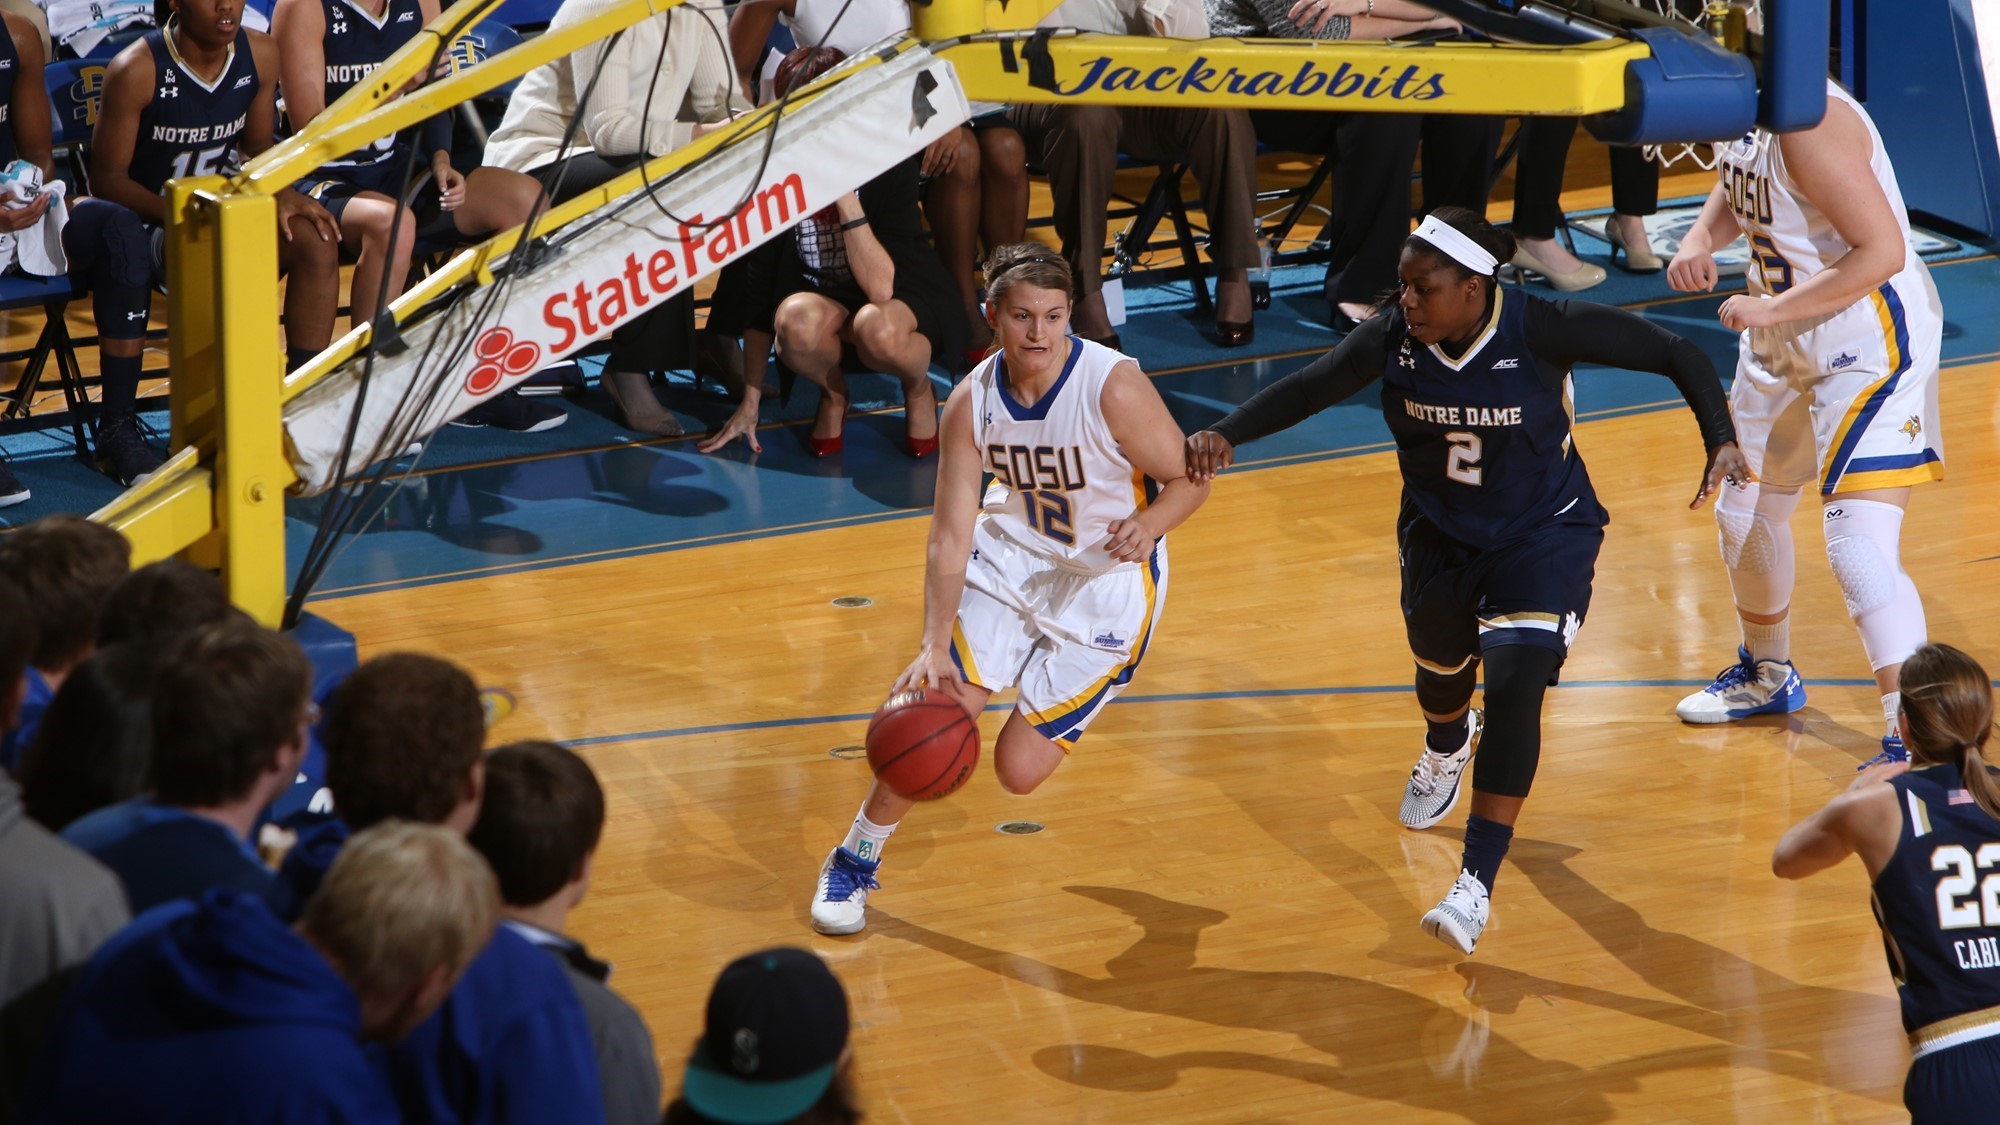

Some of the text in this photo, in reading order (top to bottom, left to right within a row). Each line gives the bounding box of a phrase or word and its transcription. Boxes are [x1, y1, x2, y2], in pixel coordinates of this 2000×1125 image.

[396, 11, 415, 23] ACC
[0, 59, 11, 69] CC
[1054, 56, 1453, 100] Jackrabbits
[233, 75, 252, 89] ACC
[152, 112, 247, 143] NOTRE DAME
[1722, 160, 1774, 226] SDSU
[1491, 358, 1519, 370] ACC
[1404, 398, 1523, 426] NOTRE DAME
[988, 444, 1087, 493] SDSU
[1445, 431, 1482, 486] 2
[1020, 489, 1077, 548] 12
